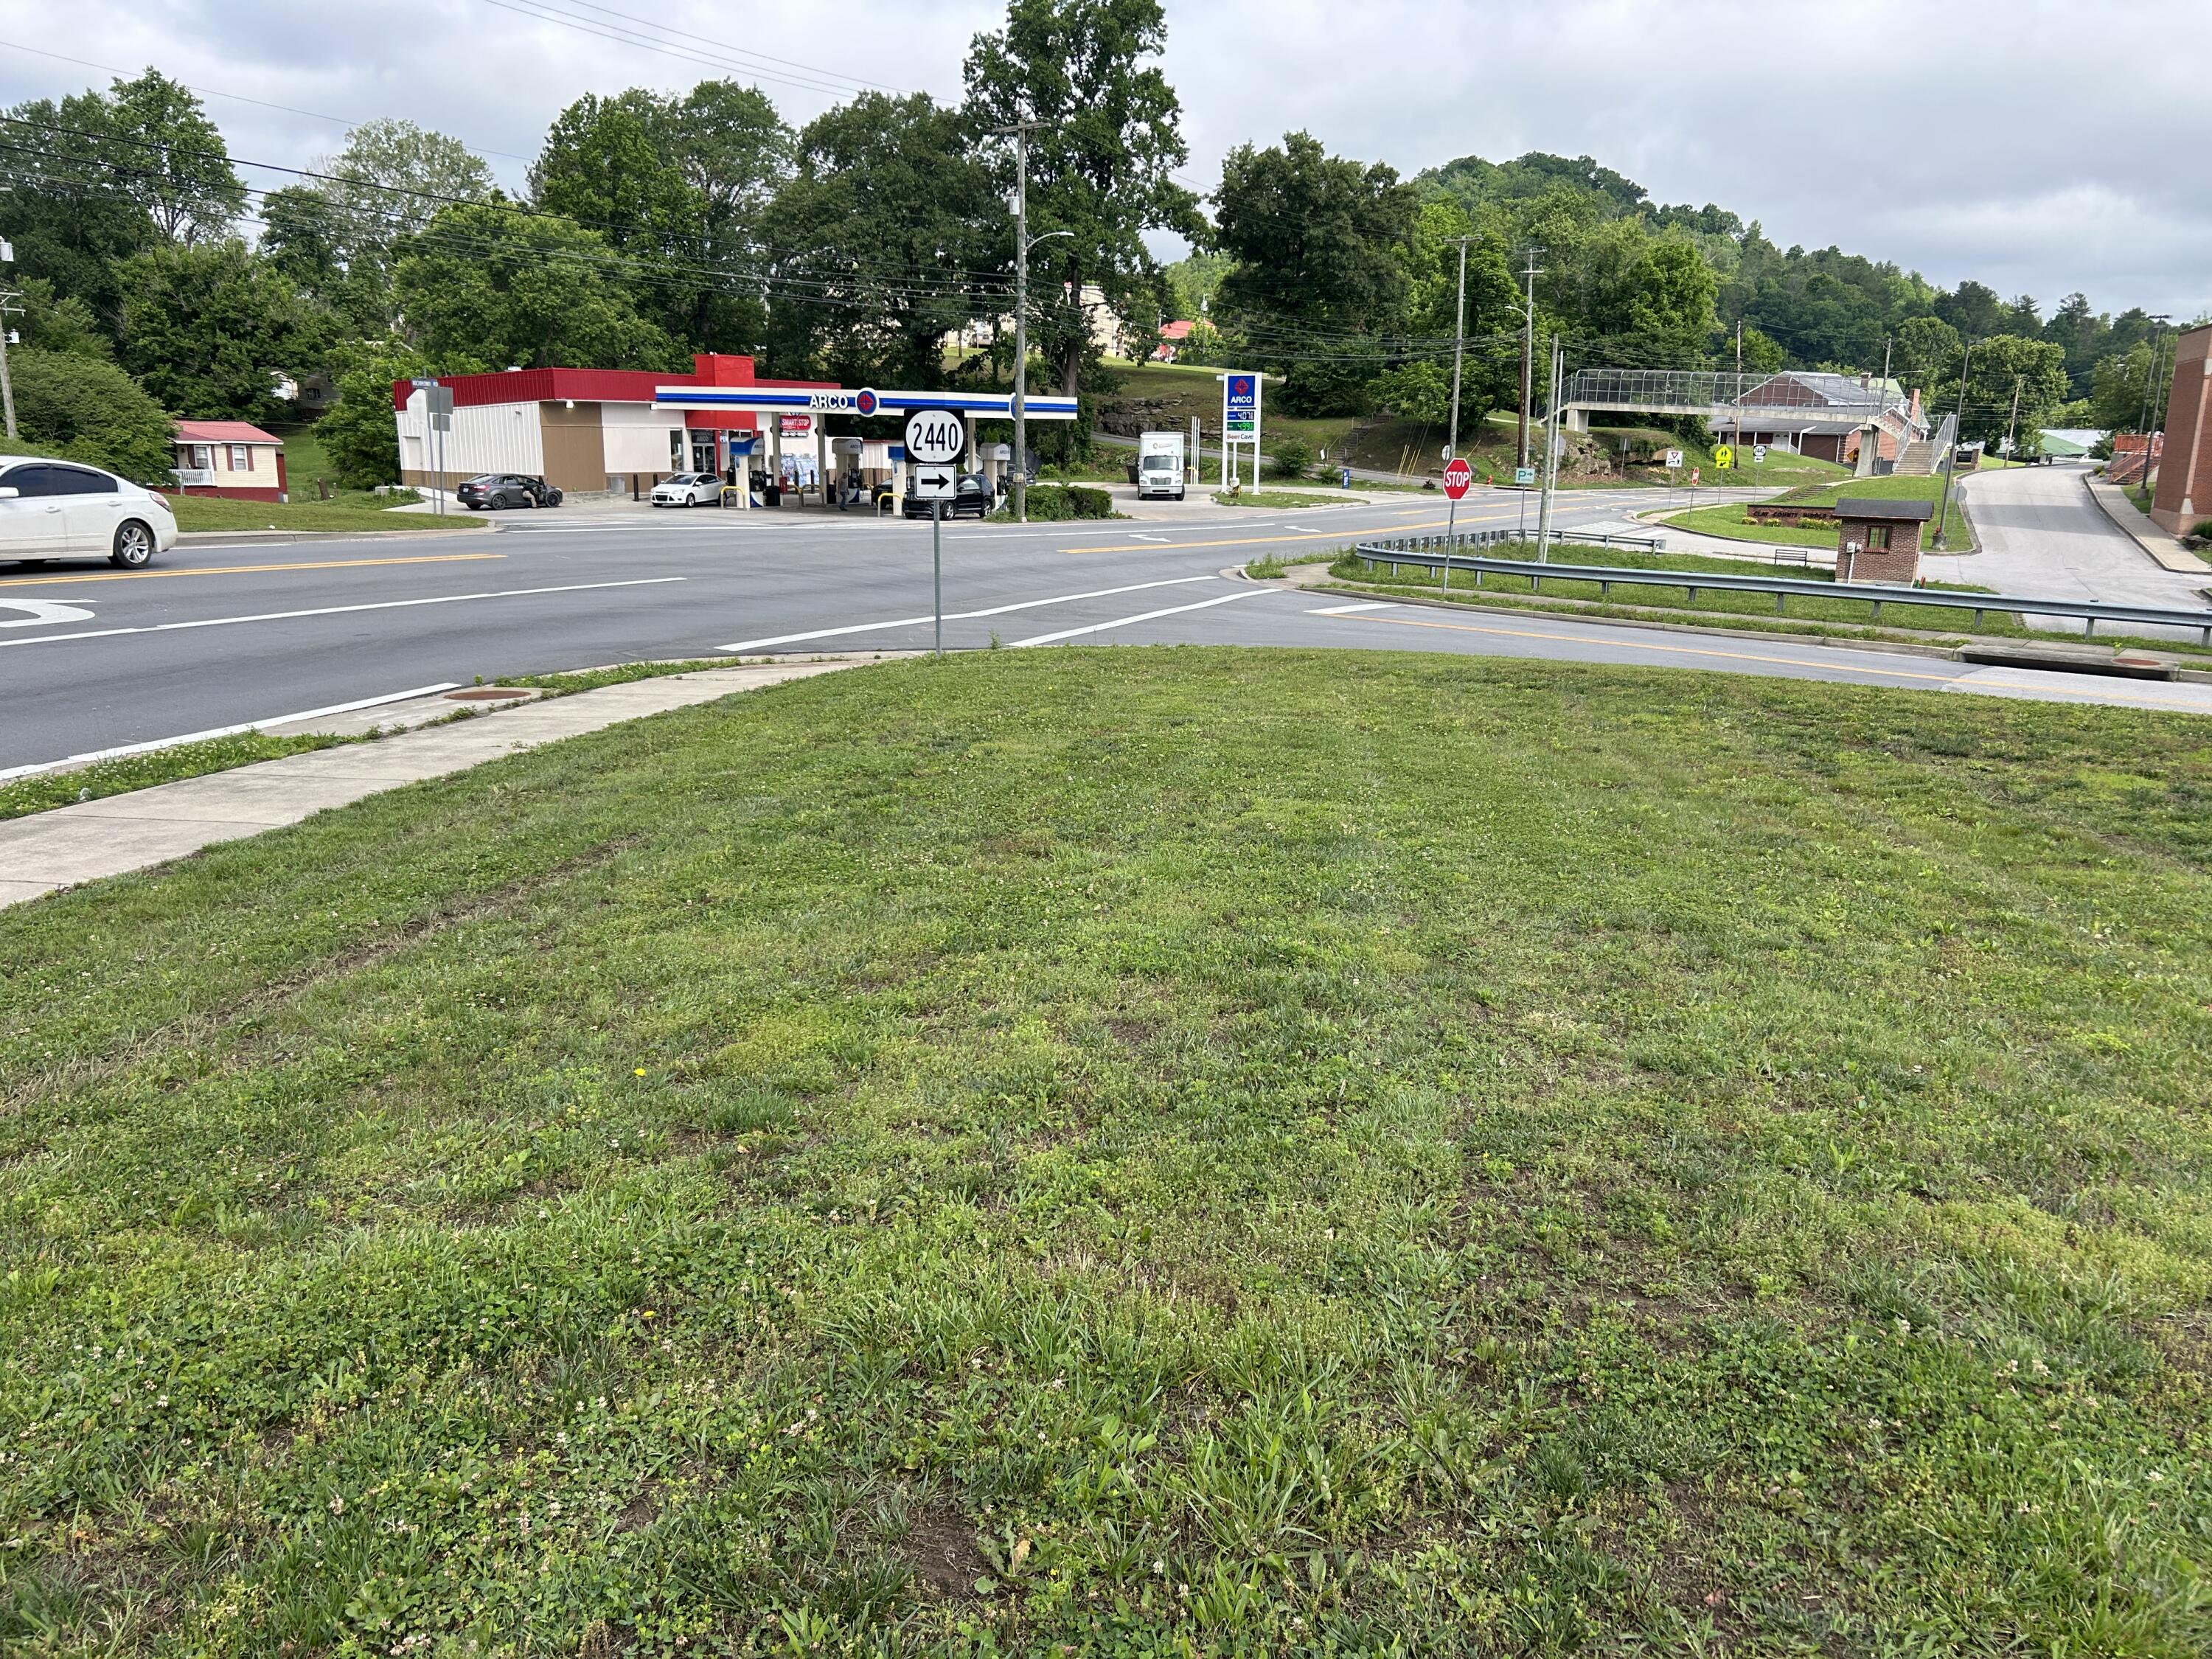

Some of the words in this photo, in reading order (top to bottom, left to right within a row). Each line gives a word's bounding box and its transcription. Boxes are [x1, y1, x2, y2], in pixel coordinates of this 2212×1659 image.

[810, 393, 848, 409] ARCO
[1231, 396, 1252, 404] ARCO
[782, 418, 797, 426] SMART
[798, 419, 810, 427] STOP
[913, 422, 959, 451] 2440
[1445, 470, 1470, 487] STOP
[1518, 470, 1526, 481] P
